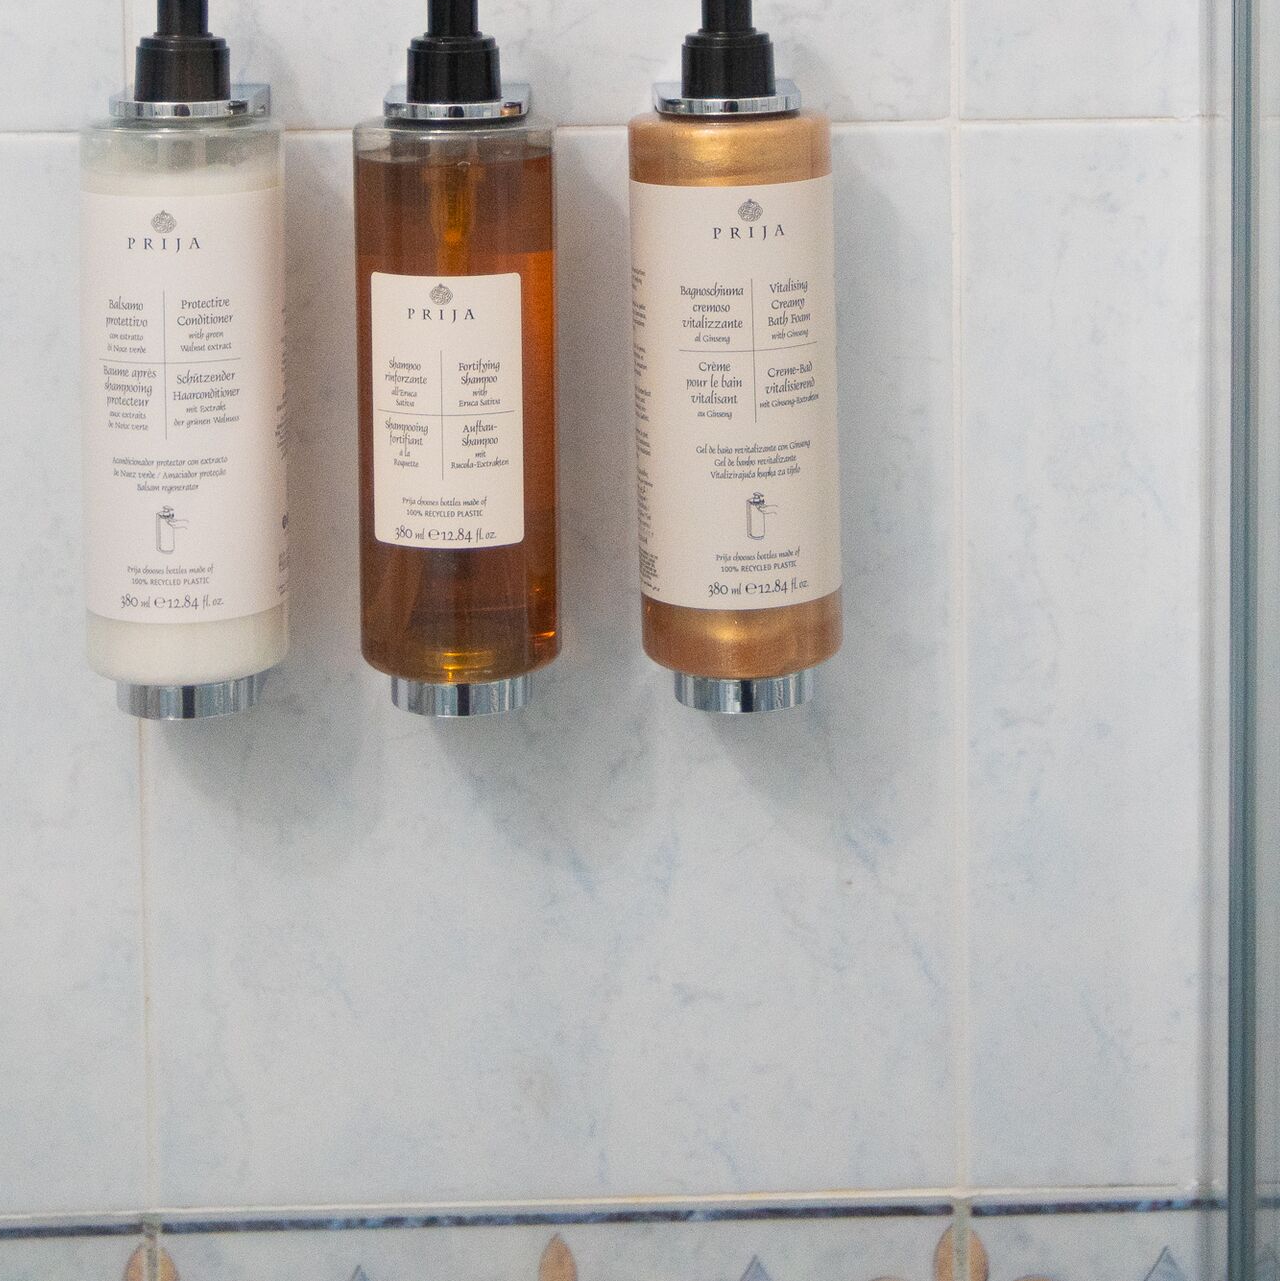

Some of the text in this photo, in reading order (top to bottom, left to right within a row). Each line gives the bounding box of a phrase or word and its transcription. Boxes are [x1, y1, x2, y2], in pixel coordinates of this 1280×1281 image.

[713, 224, 785, 240] PRIJA
[128, 237, 201, 253] PRIJA
[680, 282, 744, 300] Bagnoschiuma
[769, 278, 808, 294] Vitalising
[109, 296, 143, 310] Balsamo
[181, 296, 230, 309] Protective
[692, 304, 730, 312] cremoso
[771, 298, 805, 310] Creamy
[106, 316, 148, 328] protettivo
[176, 313, 233, 326] Conditioner
[408, 308, 475, 323] PRIJA
[682, 314, 744, 328] vitalizzante
[768, 310, 811, 327] Bath Foam
[702, 334, 730, 344] Ginseng
[772, 329, 786, 340] with
[389, 356, 422, 372] Shampoo
[458, 358, 500, 373] Fortifying
[698, 361, 731, 372] Crème
[768, 361, 812, 378] Creme-Bad
[104, 365, 158, 380] Baume après
[176, 369, 236, 386] Schützender
[385, 370, 428, 384] rinforzante
[686, 374, 742, 390] pour le bain
[765, 376, 815, 394] vitalisierend
[172, 386, 240, 400] Haarconditioner
[691, 390, 738, 404] vitalisant
[107, 396, 150, 406] protecteur
[706, 410, 732, 420] Ginseng
[385, 417, 428, 436] Shampooing
[463, 420, 498, 435] Aufbau-
[390, 430, 424, 446] fortifiant
[696, 444, 707, 454] Gel
[708, 446, 716, 454] de
[714, 457, 726, 466] Gel
[728, 458, 734, 466] de
[402, 496, 416, 506] Prija
[424, 510, 456, 518] RECYCLED
[457, 510, 483, 518] PLASTIC
[395, 524, 412, 540] 380
[415, 528, 425, 540] ml
[440, 528, 472, 542] 12.84
[716, 554, 731, 562] Prija
[741, 564, 772, 572] RECYCLED
[774, 560, 796, 570] PLASTIC
[150, 578, 180, 586] RECYCLED
[184, 577, 210, 585] PLASTIC
[708, 582, 728, 598] 380
[731, 583, 742, 594] ml
[758, 578, 788, 594] 12.84
[121, 594, 138, 608] 380
[166, 594, 200, 610] 12.84
